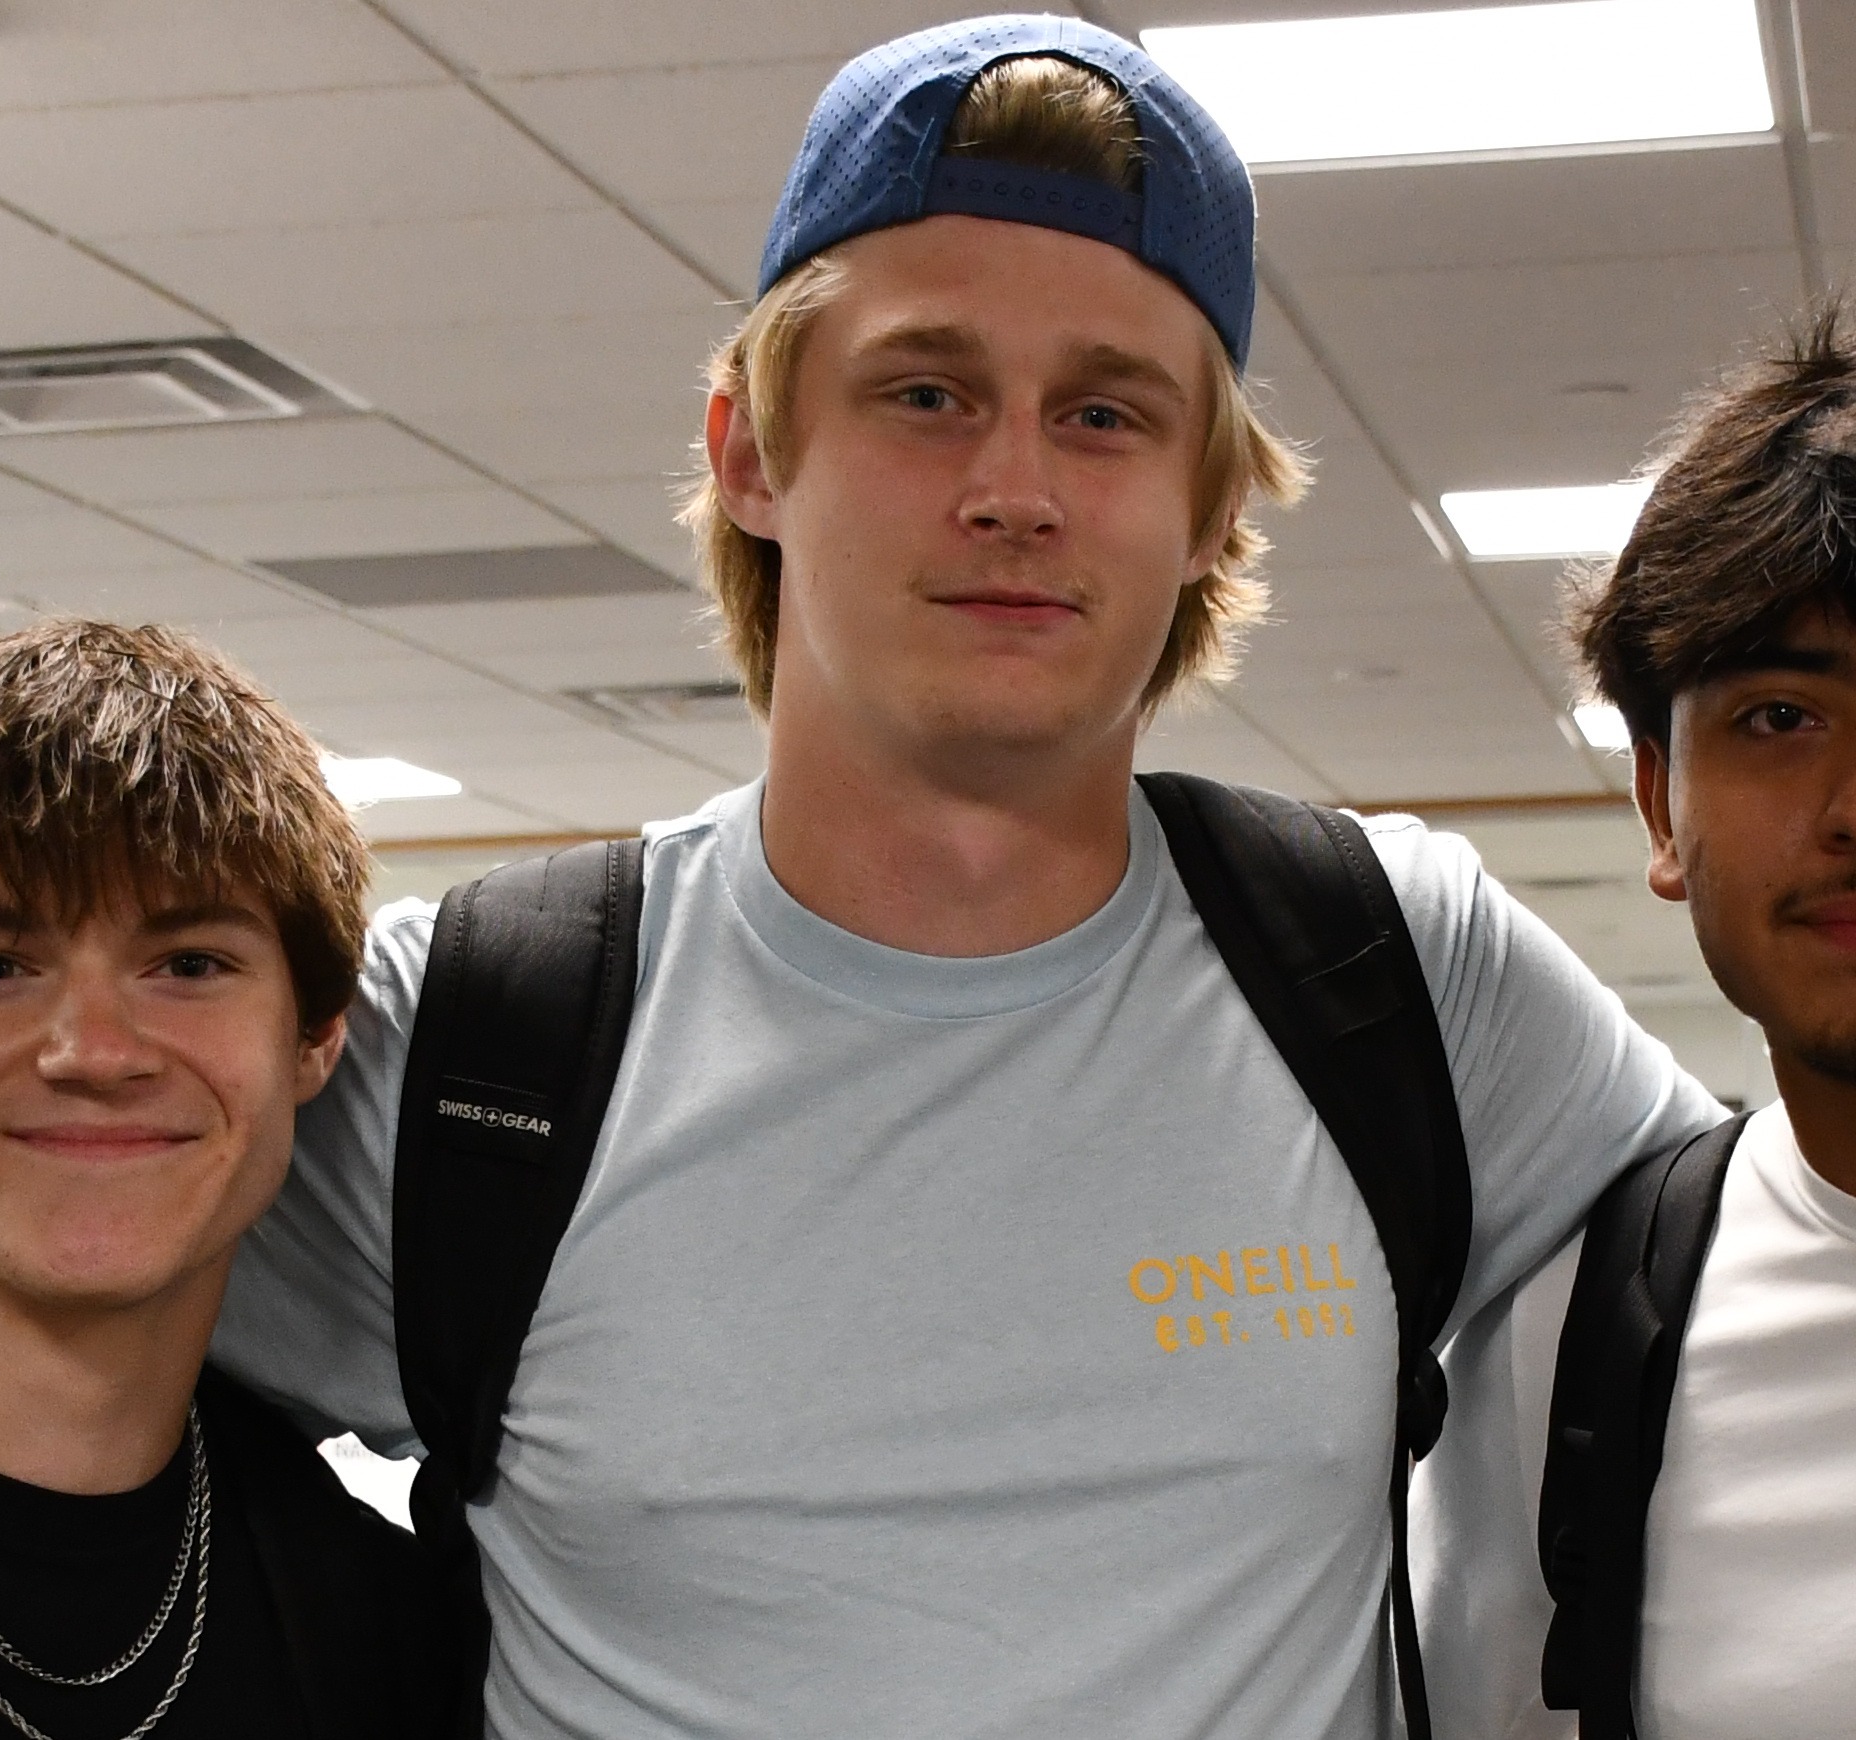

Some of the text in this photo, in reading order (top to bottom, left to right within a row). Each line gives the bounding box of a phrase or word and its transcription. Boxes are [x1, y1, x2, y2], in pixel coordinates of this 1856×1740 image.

[437, 1099, 552, 1137] SWISS GEAR
[1128, 1243, 1357, 1304] O'NEILL
[1155, 1311, 1250, 1353] EST.
